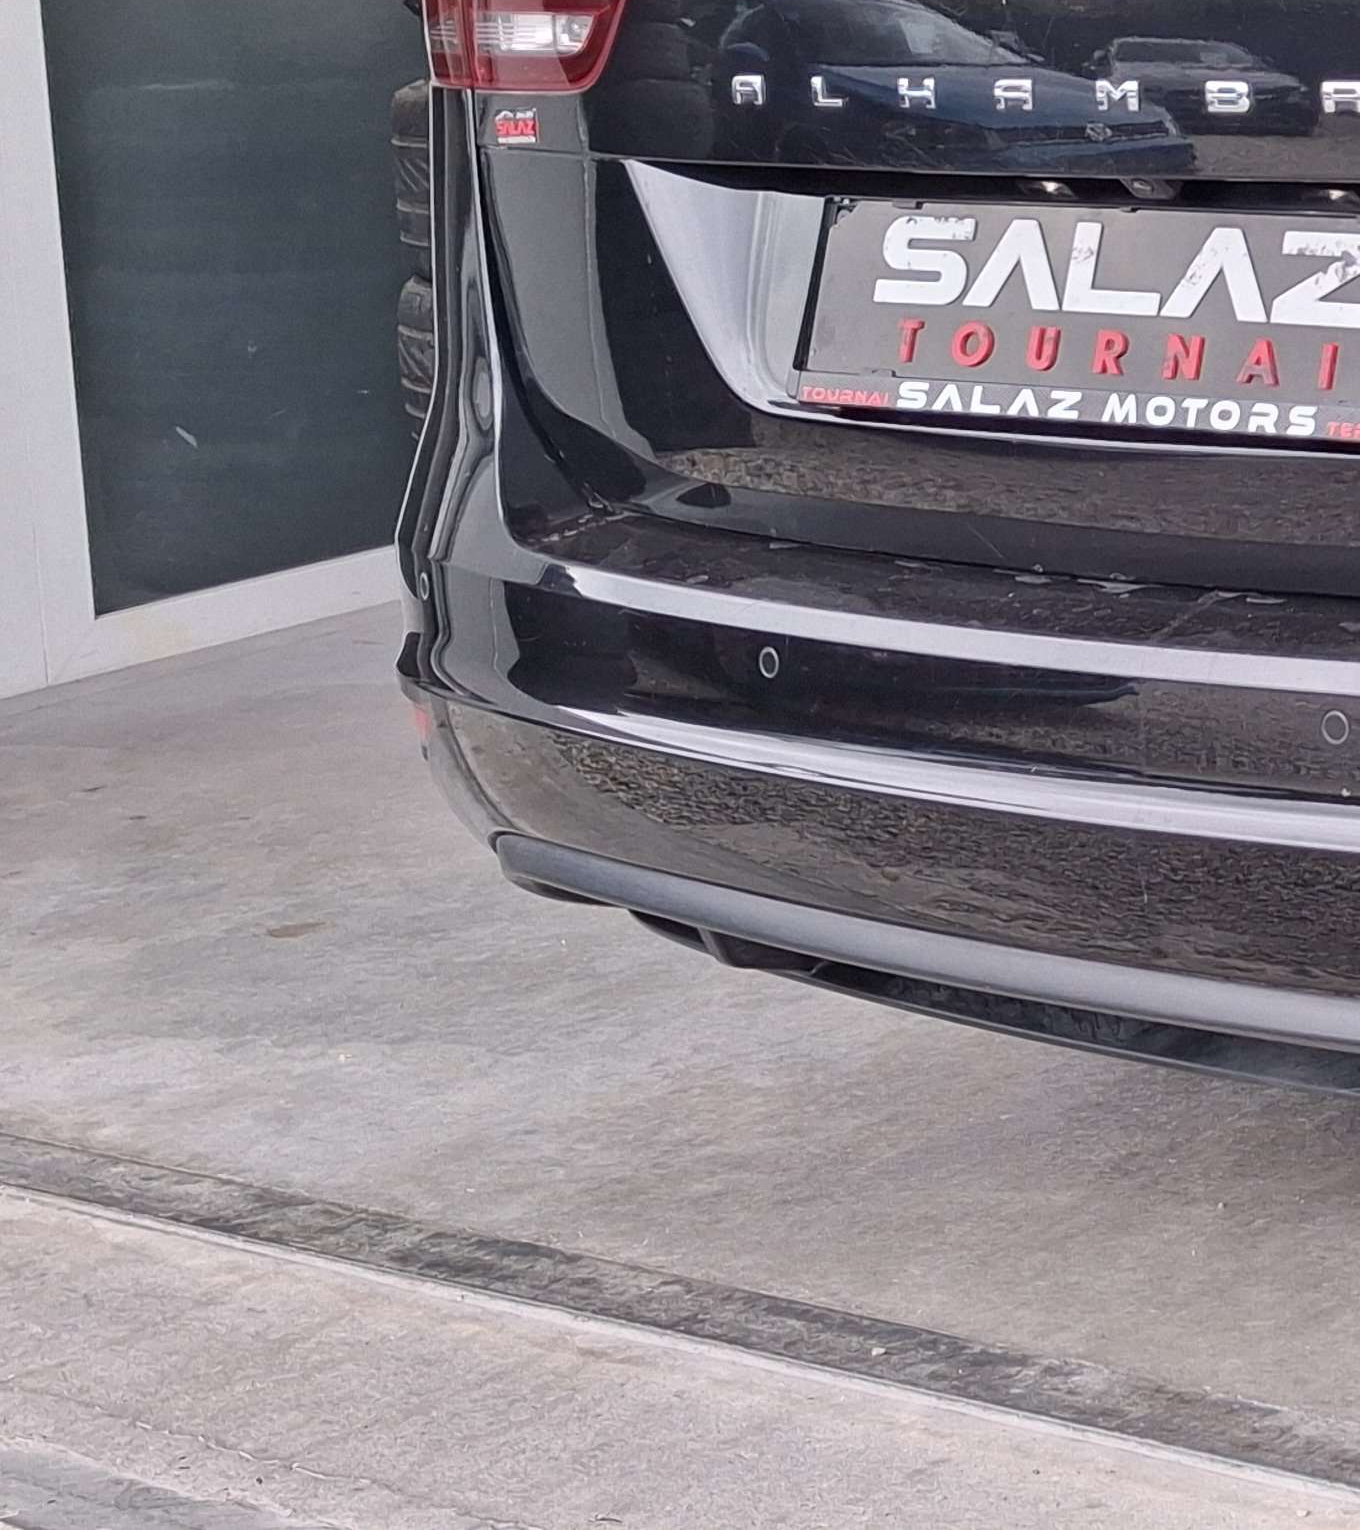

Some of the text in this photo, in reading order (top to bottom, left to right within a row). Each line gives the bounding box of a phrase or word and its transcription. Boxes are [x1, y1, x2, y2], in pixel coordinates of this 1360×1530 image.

[896, 318, 1341, 391] TOURNAI
[802, 386, 889, 407] TOURNAI
[896, 381, 1083, 421] SALAZ
[1101, 392, 1319, 436] MOTORS
